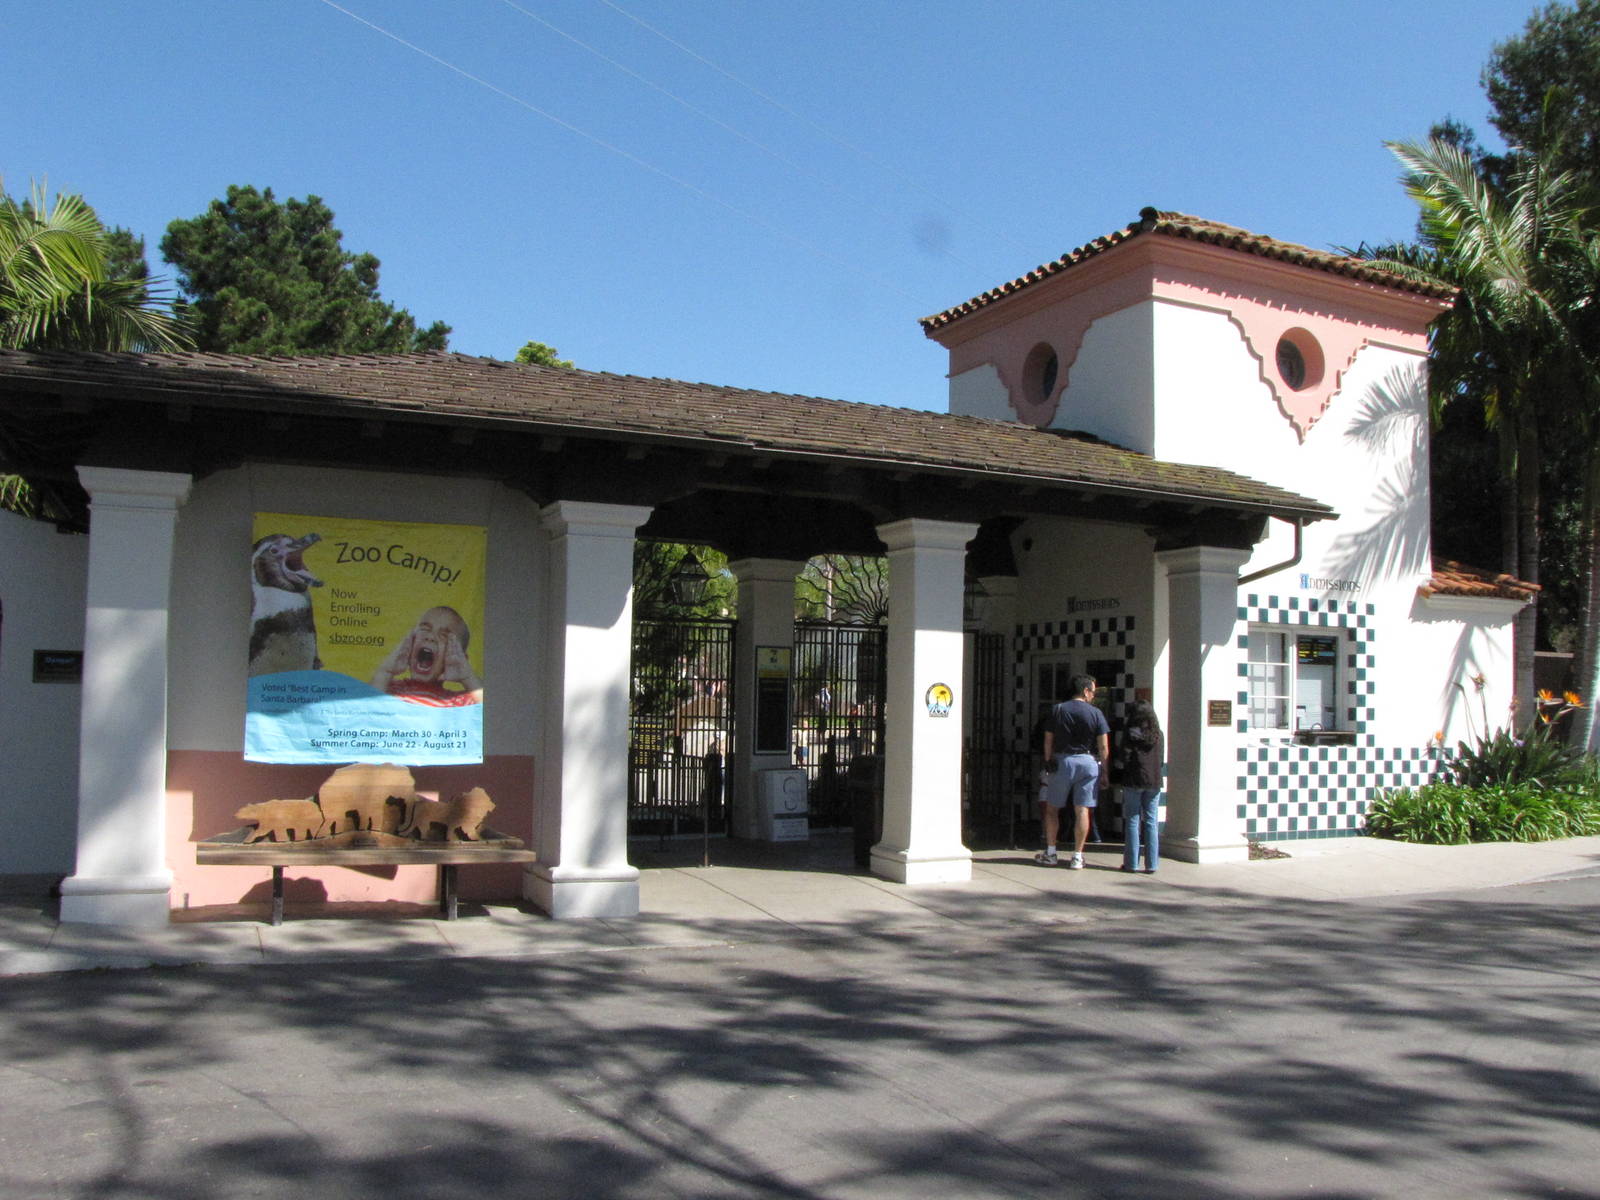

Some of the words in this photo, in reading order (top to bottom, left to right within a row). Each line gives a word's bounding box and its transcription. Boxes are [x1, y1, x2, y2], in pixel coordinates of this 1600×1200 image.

[334, 541, 382, 564] Zoo
[386, 544, 462, 587] Camp!
[331, 588, 358, 599] Now
[330, 601, 381, 617] Enrolling
[329, 616, 368, 628] Online
[329, 632, 385, 647] sbzoo.org
[262, 682, 286, 693] Voted
[311, 684, 336, 695] Camp
[336, 686, 346, 694] in
[261, 693, 286, 703] Santa
[327, 728, 358, 739] Spring
[359, 729, 388, 739] Camp:
[391, 730, 419, 738] March
[421, 730, 431, 738] 30
[439, 730, 460, 740] April
[461, 730, 467, 738] 3
[310, 738, 348, 748] Summer
[350, 739, 379, 749] Camp:
[382, 740, 403, 748] June
[405, 740, 416, 748] 22
[424, 740, 454, 750] August
[456, 740, 466, 748] 21
